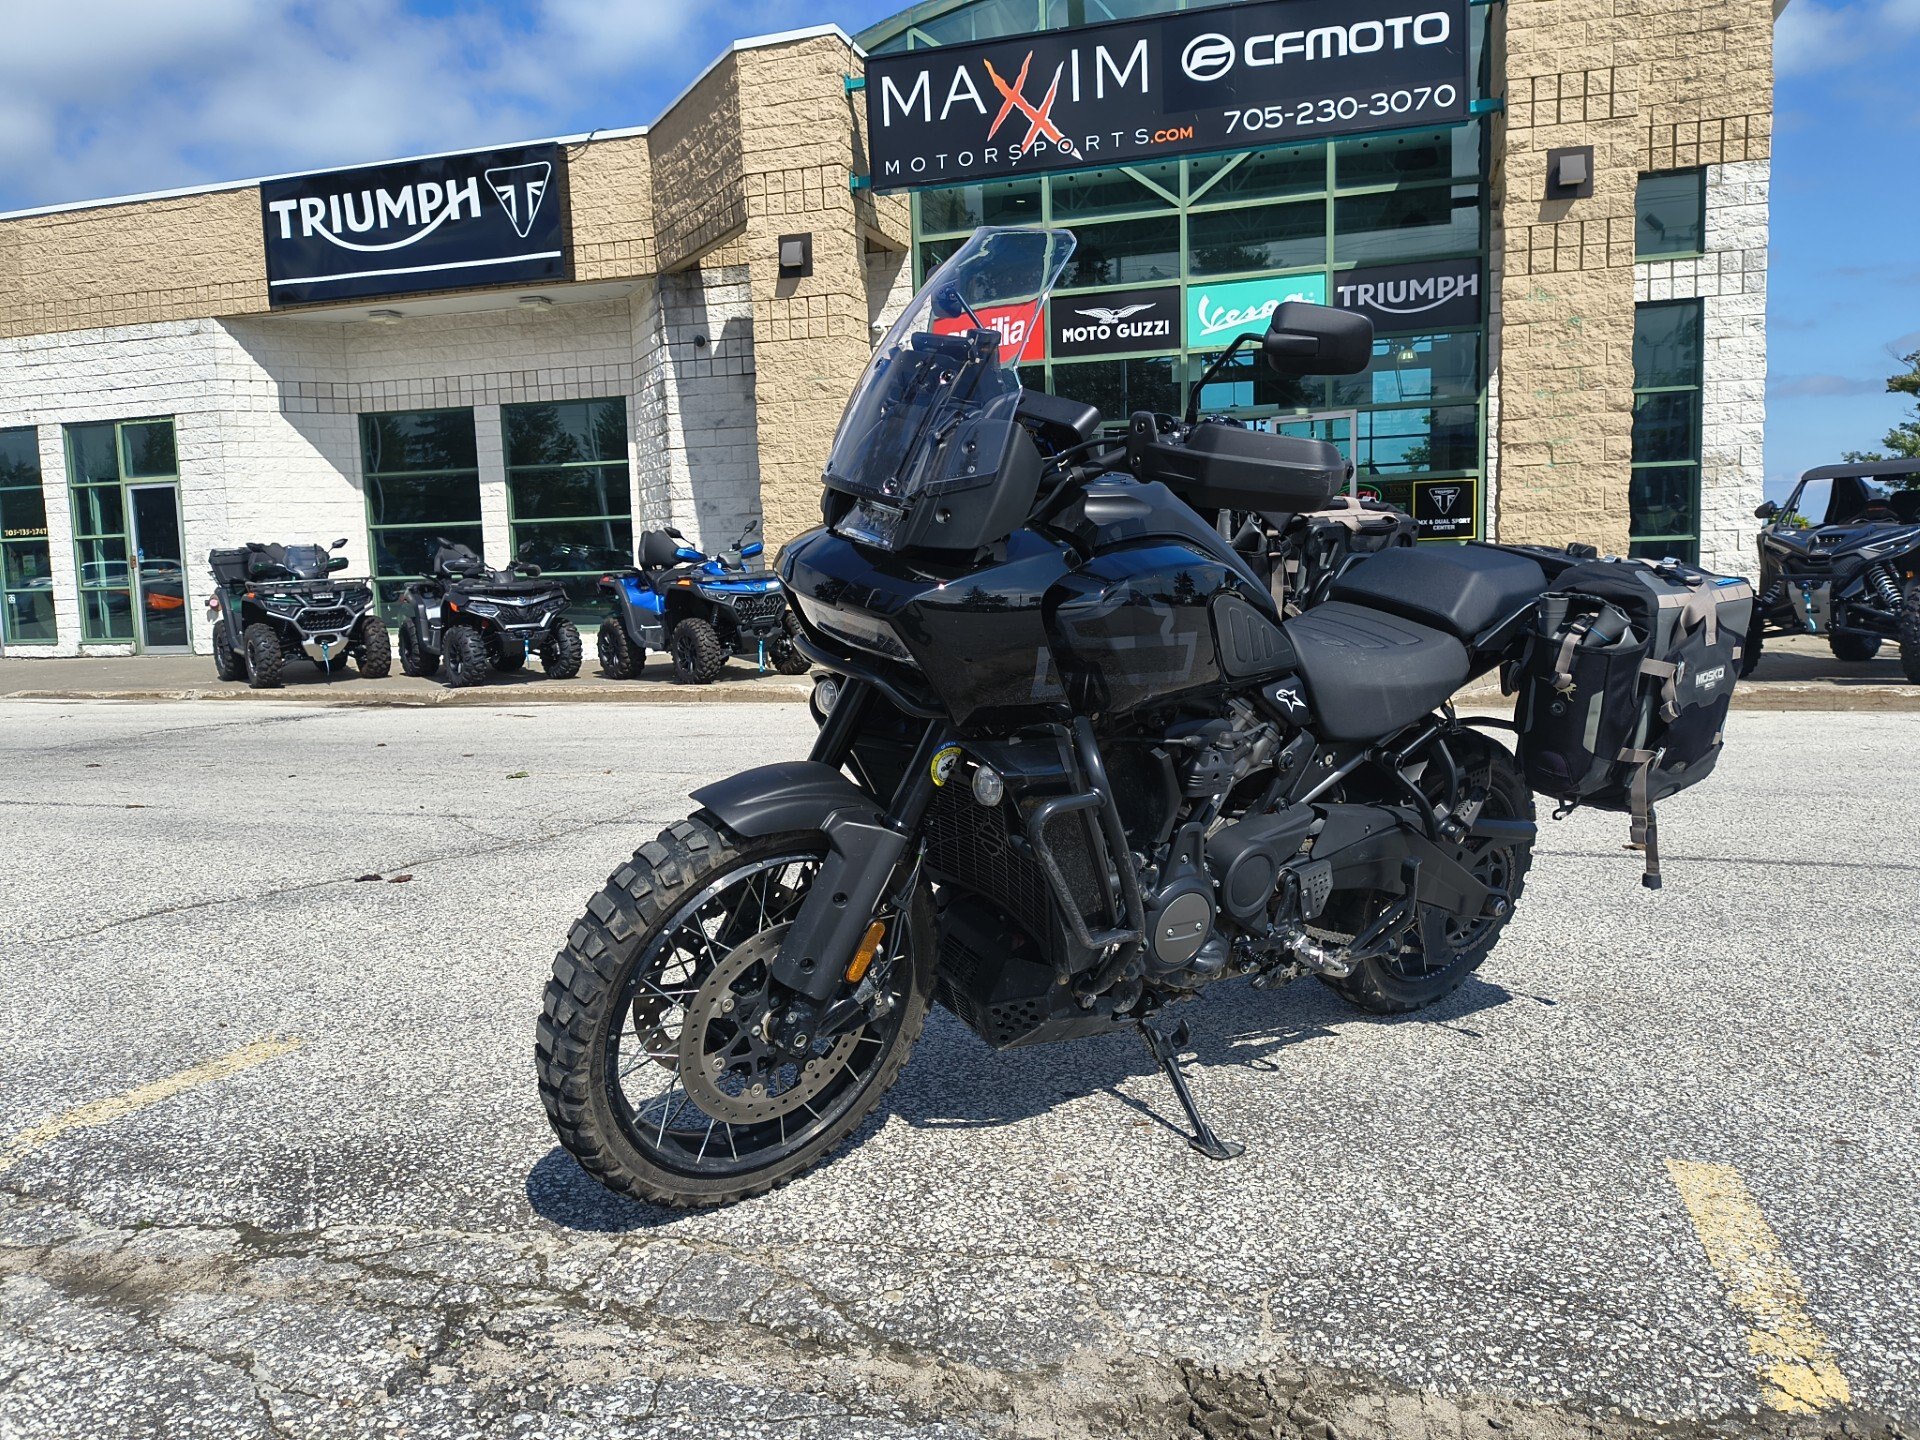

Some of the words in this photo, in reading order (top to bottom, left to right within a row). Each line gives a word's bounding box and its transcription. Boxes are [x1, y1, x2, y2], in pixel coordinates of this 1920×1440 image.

[1244, 11, 1450, 67] CFMOTO
[880, 38, 1149, 150] MAXIM
[1223, 84, 1456, 134] 705-230-3070
[269, 176, 482, 252] TRIUMPH
[1337, 273, 1478, 314] TRIUMPH
[1062, 325, 1111, 343] MOTO
[1116, 320, 1170, 338] GUZZI
[1696, 667, 1725, 687] MOSKO
